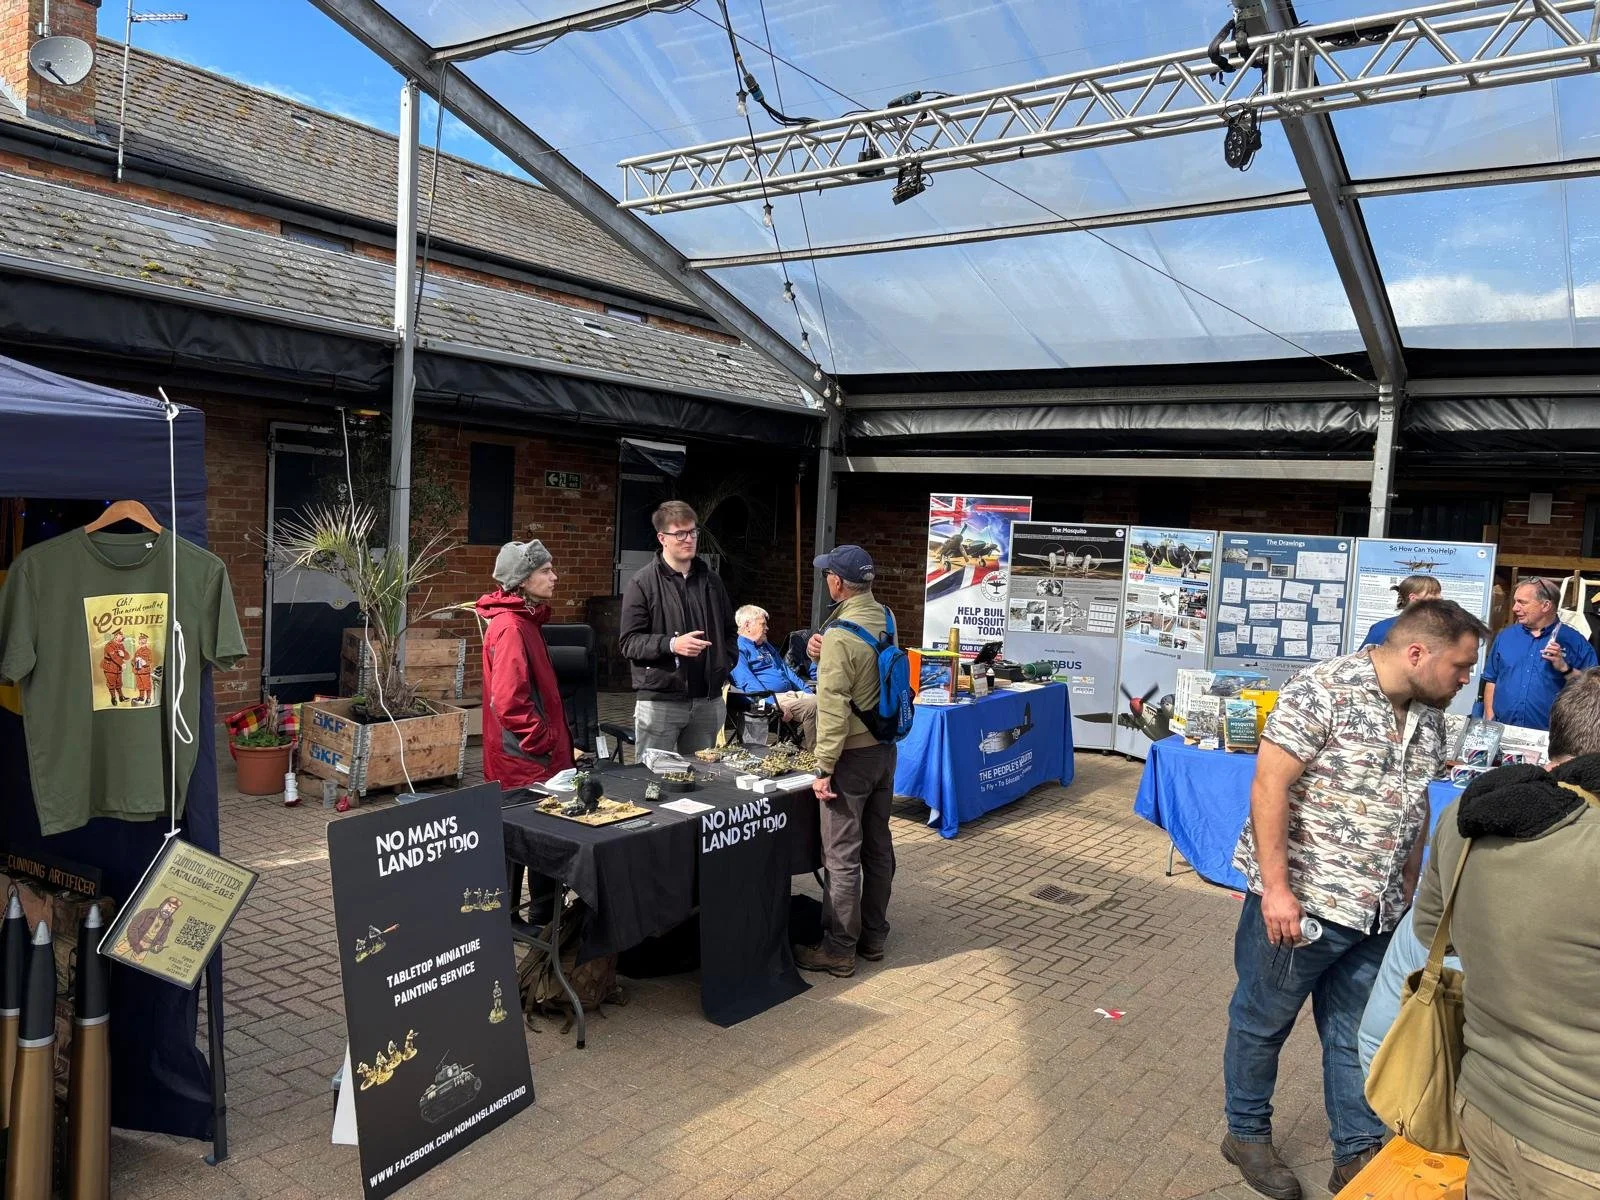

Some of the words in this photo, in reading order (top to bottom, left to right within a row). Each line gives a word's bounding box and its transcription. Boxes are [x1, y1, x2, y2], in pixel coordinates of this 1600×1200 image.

[1062, 527, 1087, 535] Mosquito
[1278, 540, 1305, 548] Drawings
[1398, 545, 1413, 553] How
[93, 612, 165, 633] CORDITE
[953, 615, 960, 625] A
[962, 616, 1005, 627] MOSQUIT
[957, 606, 981, 616] HELP
[983, 607, 1005, 618] BUIL
[979, 769, 992, 782] THE
[993, 761, 1019, 777] PEOPLE'S
[701, 810, 726, 834] NO
[728, 797, 771, 826] MAN'S
[375, 830, 405, 855] NO
[407, 815, 458, 847] MAN'S
[702, 826, 741, 854] LAND
[8, 854, 46, 879] CUNNING
[48, 867, 96, 896] ARTIFICER
[172, 853, 206, 875] CUNNING
[203, 867, 244, 892] ARTIFICER
[378, 847, 424, 877] LAND
[167, 865, 214, 891] CATALOGUE
[212, 886, 236, 900] 2025
[386, 958, 433, 988] TABLETOP
[435, 938, 481, 967] MINIATURE
[394, 977, 438, 1007] PAINTING
[440, 961, 476, 986] SERVICE
[369, 1084, 527, 1189] WWW.FACEBOOK.COM/NOMANSLANDSTUDIO
